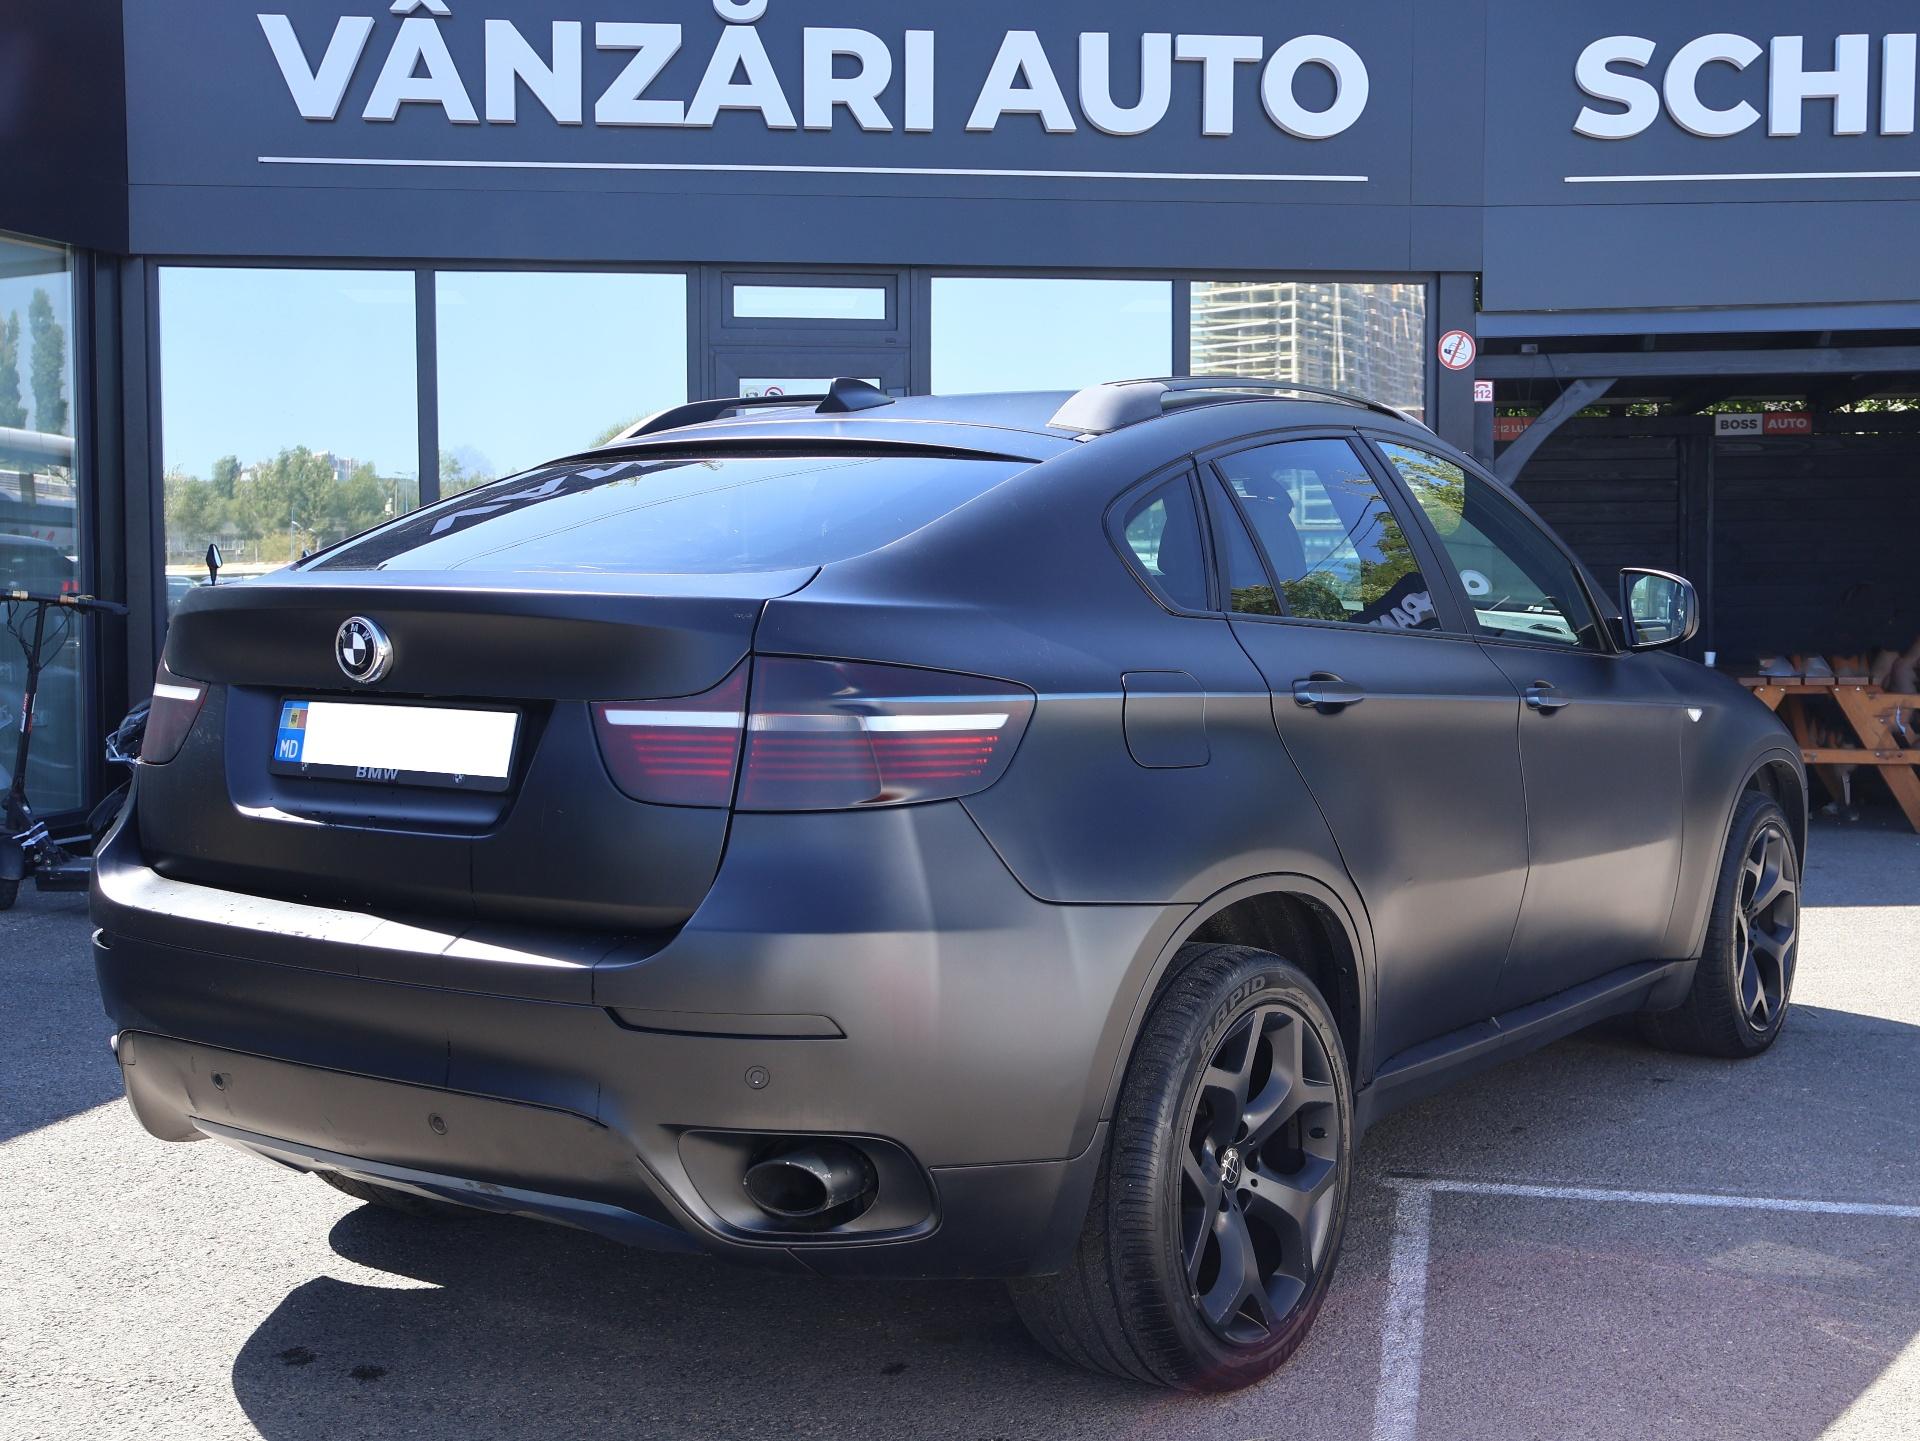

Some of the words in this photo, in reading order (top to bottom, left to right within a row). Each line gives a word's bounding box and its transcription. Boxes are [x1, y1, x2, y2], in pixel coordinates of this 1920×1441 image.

[257, 0, 934, 133] VÂNZĂRI
[965, 30, 1369, 139] AUTO
[1573, 33, 1917, 139] SCHI
[1474, 390, 1491, 399] 112
[1720, 420, 1758, 430] BOSS
[1768, 418, 1807, 429] AUTO
[341, 623, 371, 640] BMW
[280, 739, 298, 758] MD
[356, 766, 398, 780] BMW
[1200, 974, 1266, 1053] RAPID
